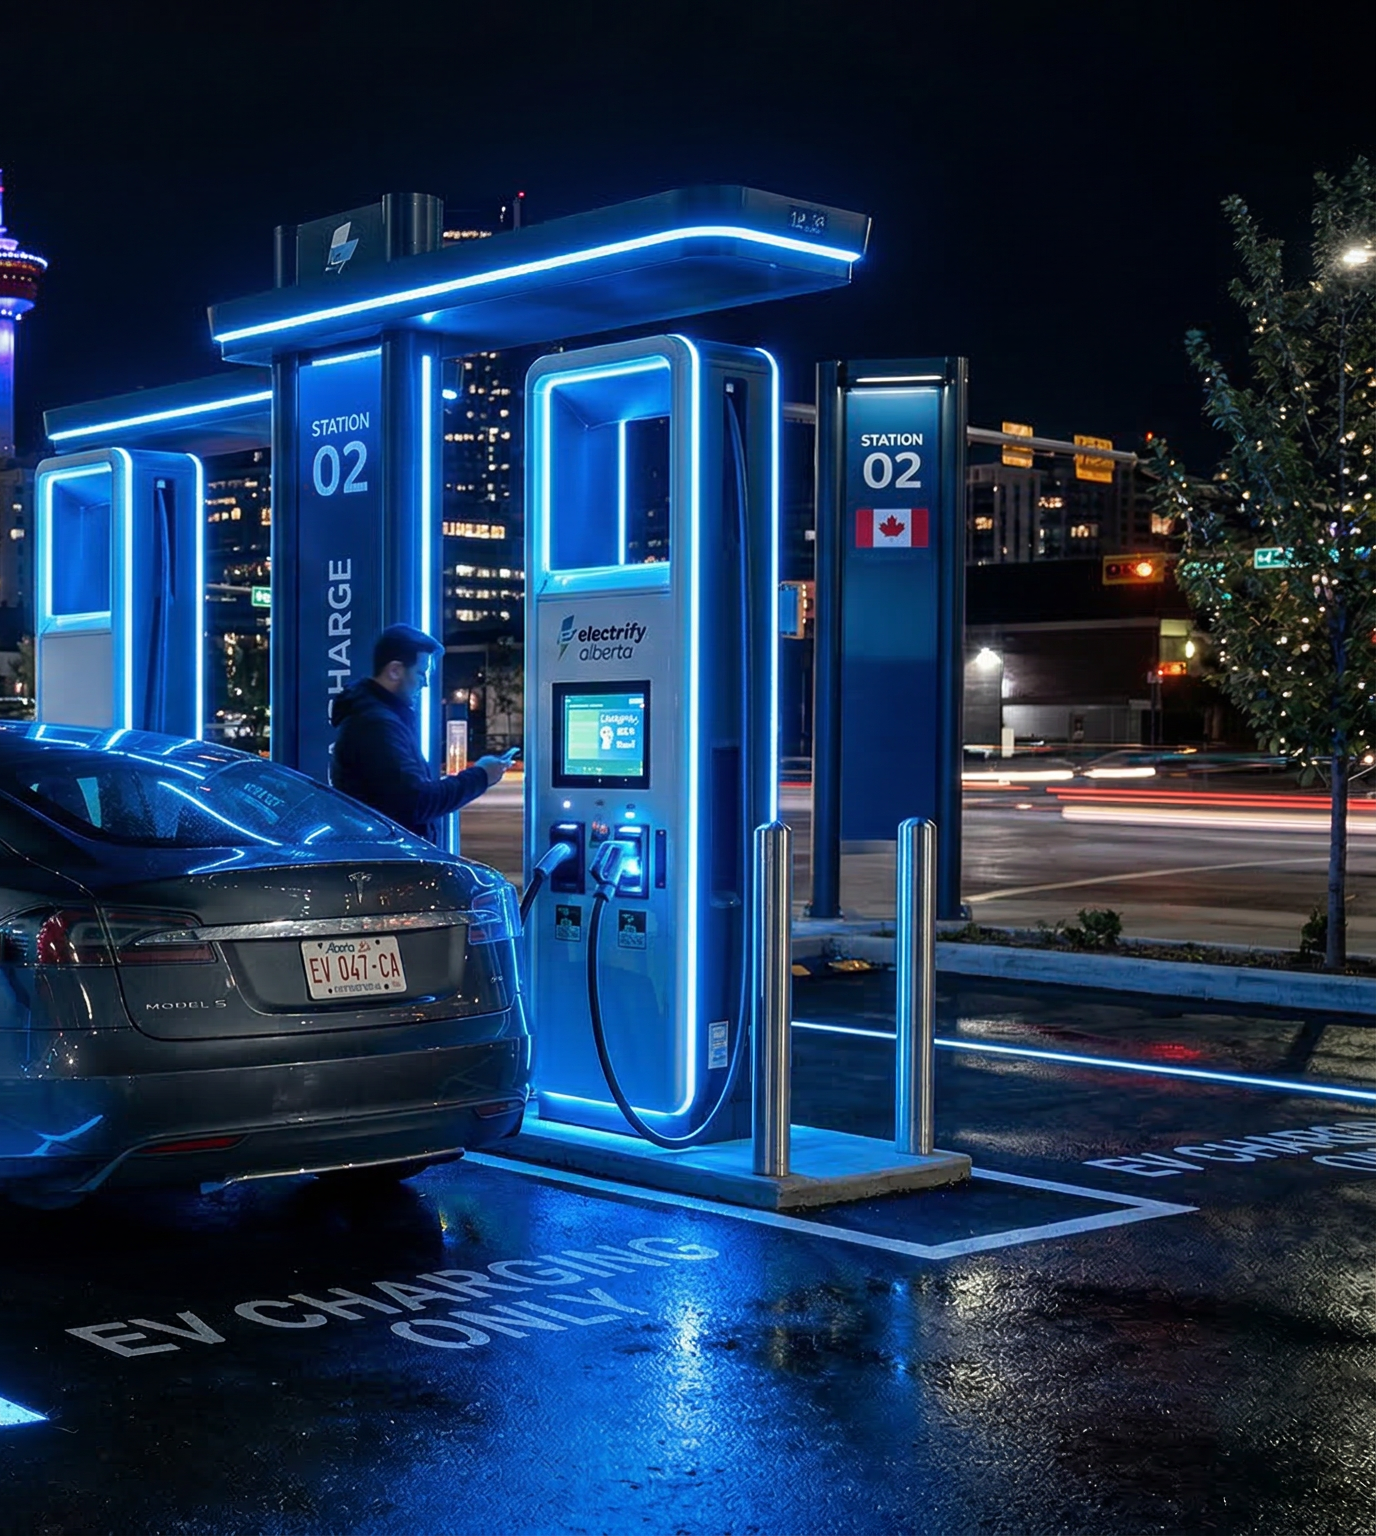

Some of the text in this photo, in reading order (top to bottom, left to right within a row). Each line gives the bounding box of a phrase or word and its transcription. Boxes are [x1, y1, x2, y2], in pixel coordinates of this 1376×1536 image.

[311, 411, 370, 437] STATION
[861, 433, 924, 447] STATION
[312, 440, 368, 496] 02
[863, 451, 922, 489] 02
[327, 558, 352, 726] HARGE
[578, 622, 647, 644] electrify
[579, 643, 634, 661] alberta
[309, 952, 401, 984] EV 047-CA
[146, 999, 228, 1011] MODEL S
[1082, 1153, 1205, 1177] EV
[64, 1237, 719, 1358] EV CHARGING
[390, 1287, 649, 1349] ONLY
